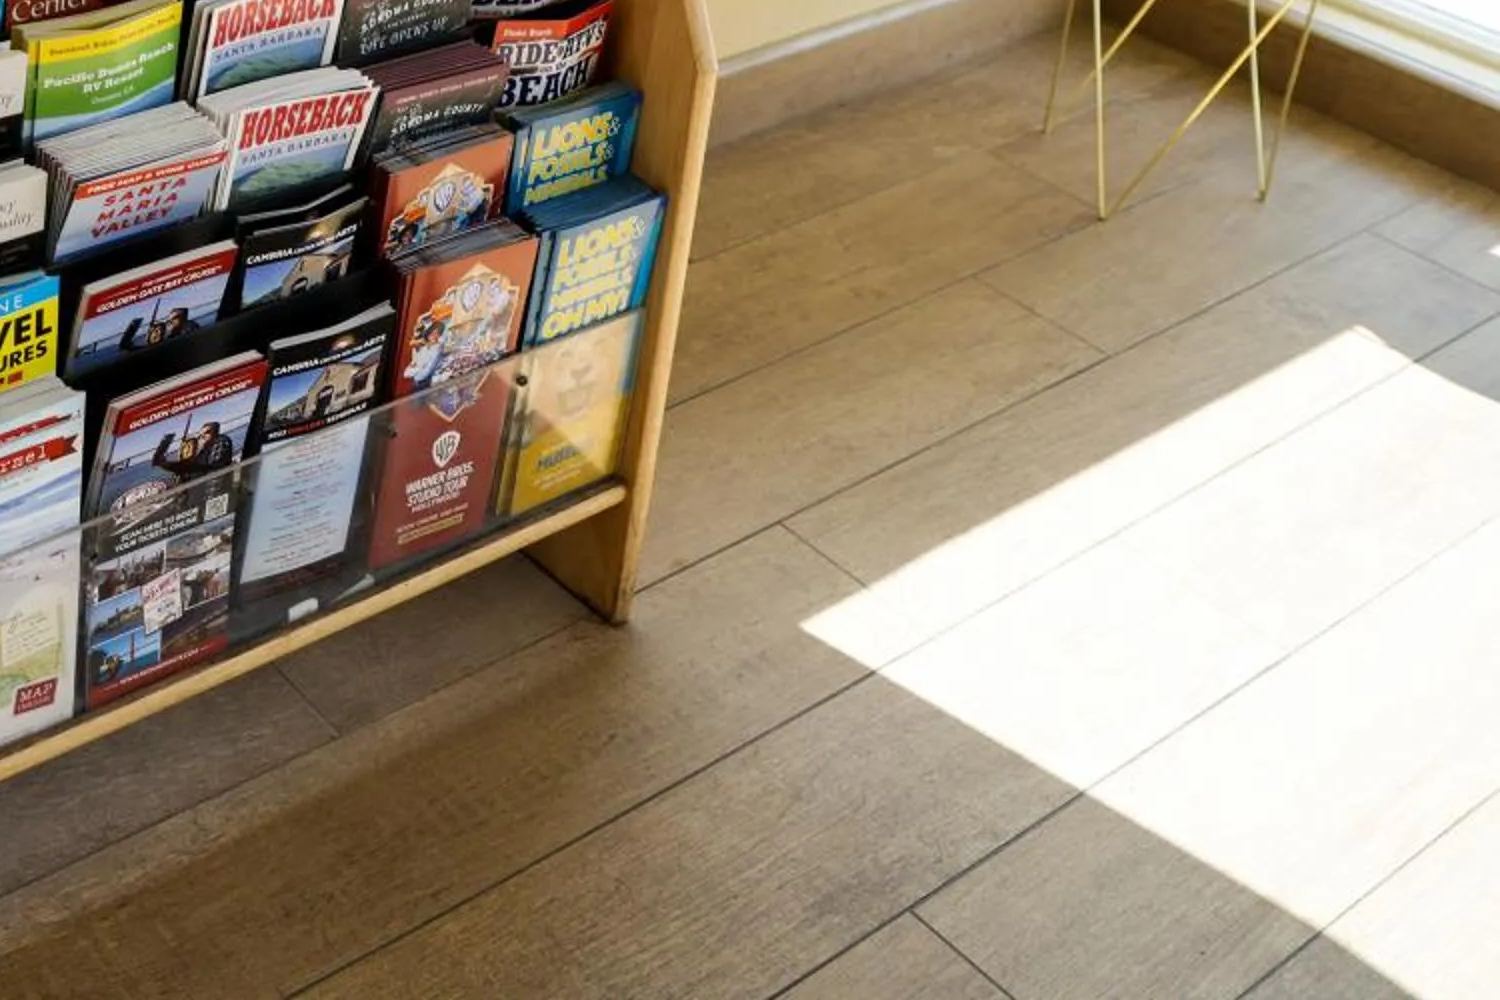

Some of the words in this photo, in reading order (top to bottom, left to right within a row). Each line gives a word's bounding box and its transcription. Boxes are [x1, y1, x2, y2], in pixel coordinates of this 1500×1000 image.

[43, 71, 96, 91] Pacific
[83, 80, 99, 95] RV
[239, 89, 371, 150] HORSEBACK
[534, 111, 613, 156] LIONS
[103, 177, 186, 206] SANTA
[91, 206, 173, 238] VALLEY
[97, 193, 178, 222] MARIA
[16, 680, 55, 702] MAP
